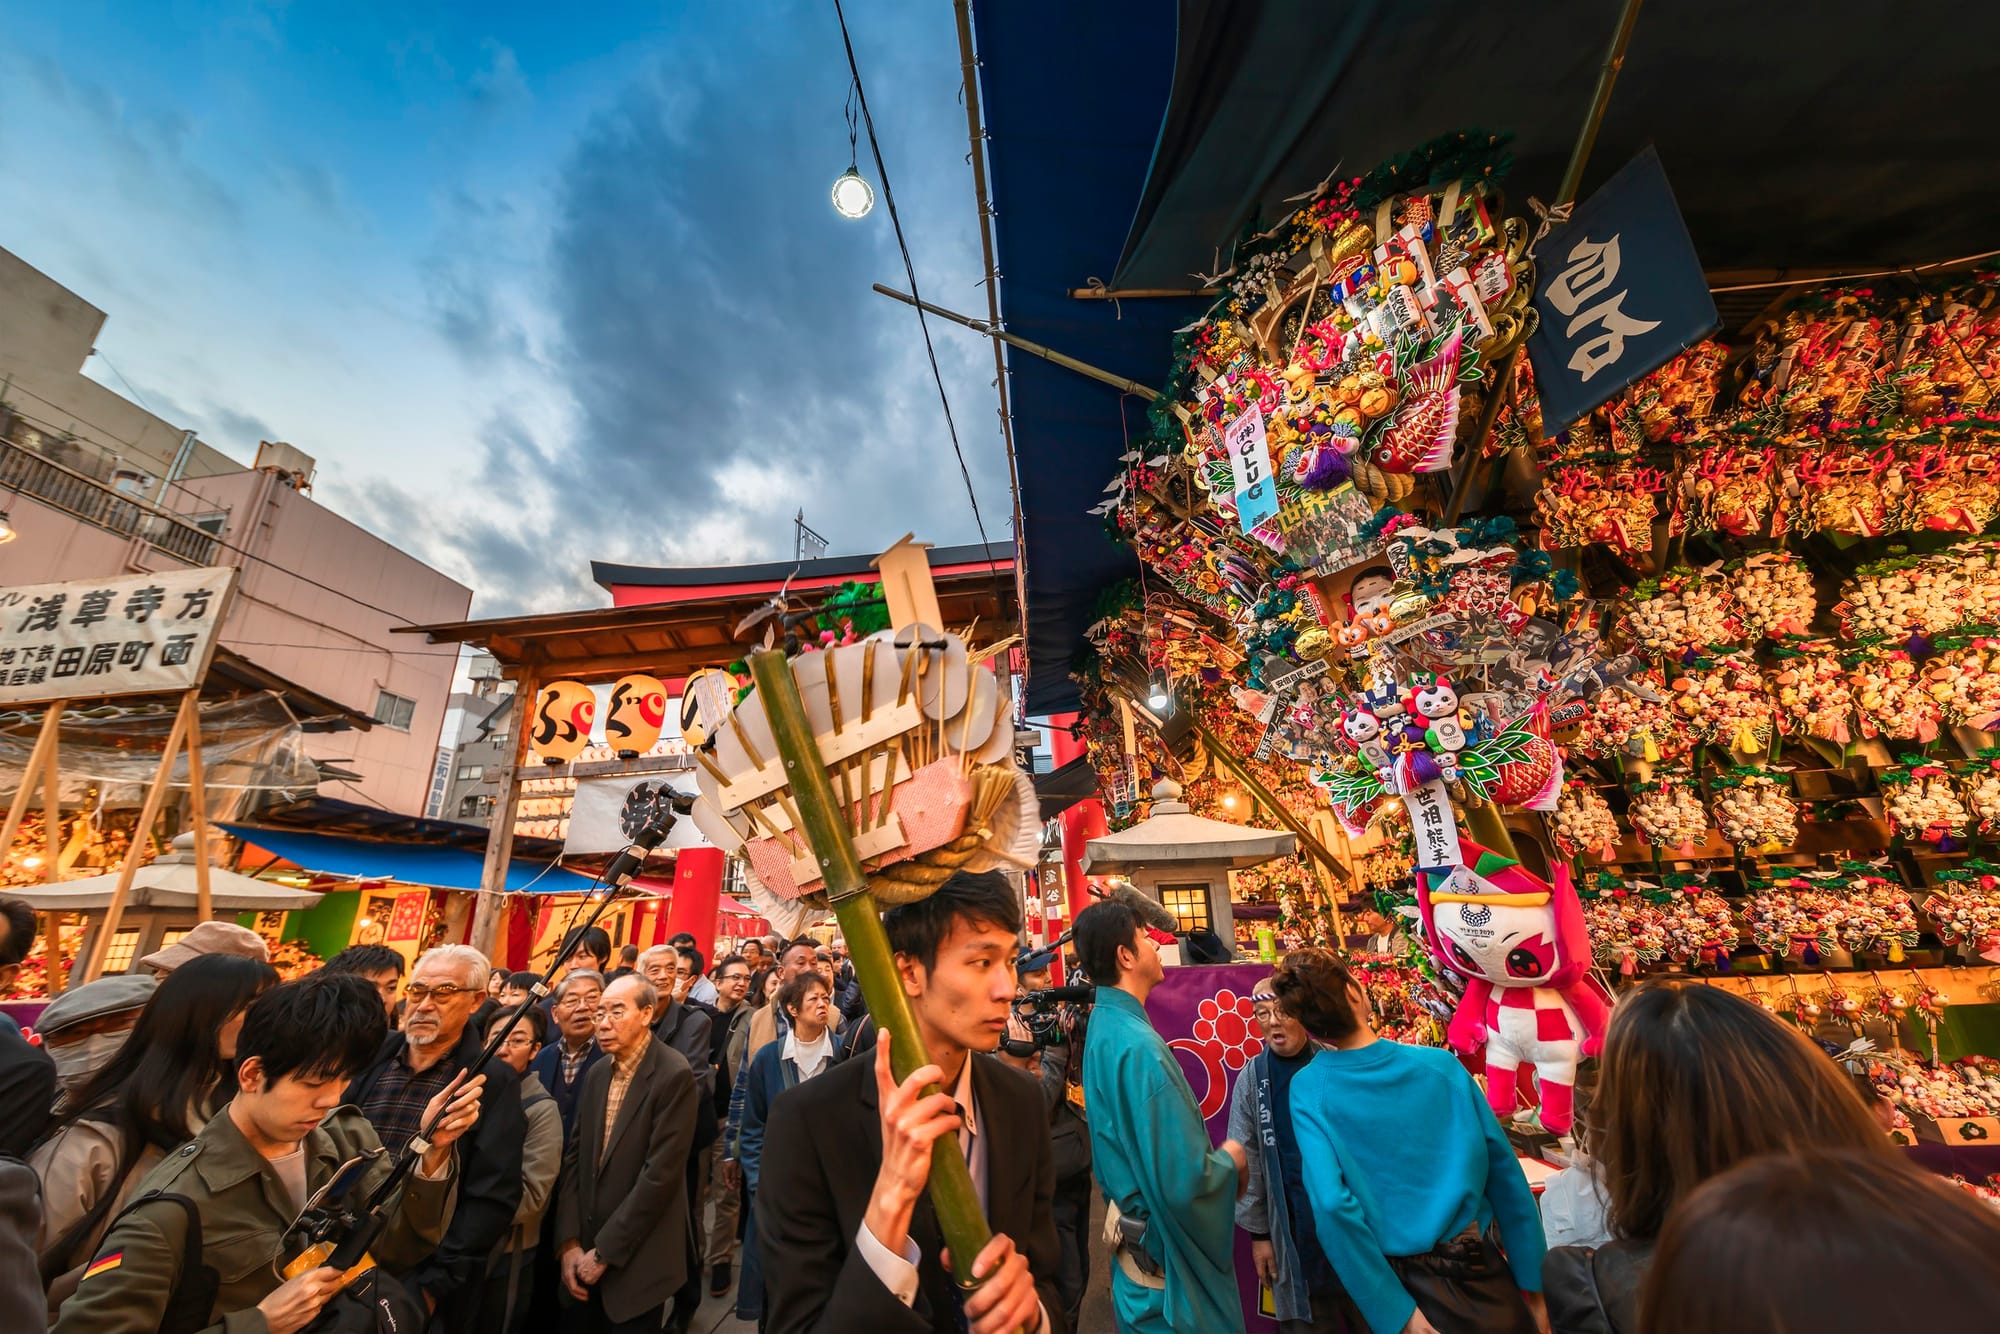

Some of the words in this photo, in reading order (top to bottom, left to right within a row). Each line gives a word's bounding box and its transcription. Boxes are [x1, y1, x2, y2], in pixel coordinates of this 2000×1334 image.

[17, 585, 165, 633] 浅草寺
[52, 641, 153, 678] 田原町
[532, 690, 577, 744] ふ
[605, 683, 642, 738] ぐ
[1414, 787, 1450, 866] 世相熊手
